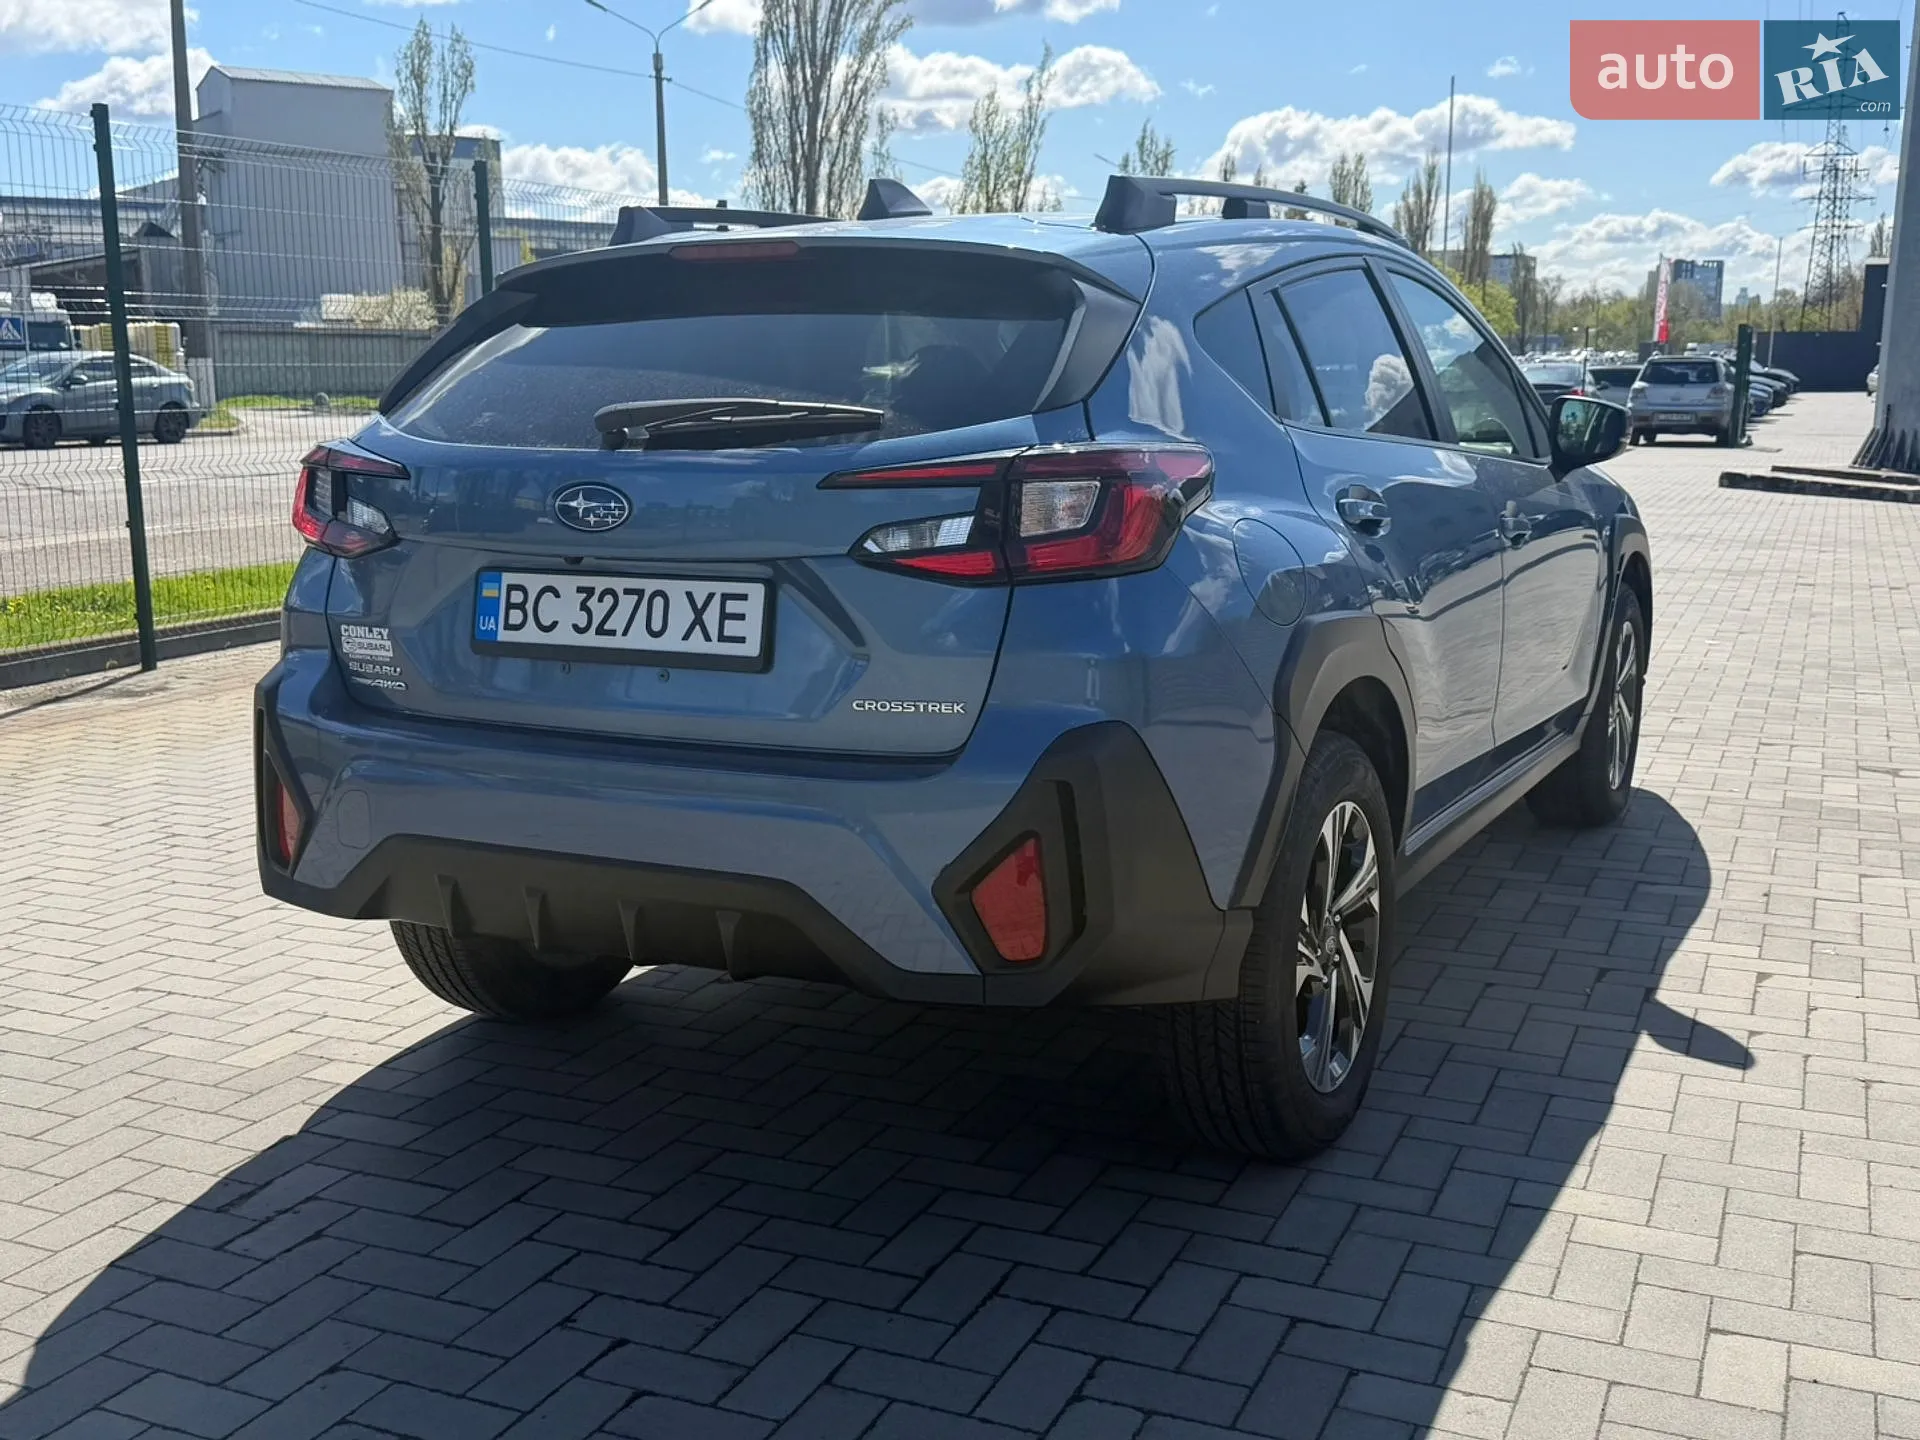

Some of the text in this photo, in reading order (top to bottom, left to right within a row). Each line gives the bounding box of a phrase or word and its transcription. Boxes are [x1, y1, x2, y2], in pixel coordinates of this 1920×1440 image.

[503, 583, 749, 644] BC 3270 XE
[479, 615, 497, 631] UA
[341, 624, 388, 640] CONLEY
[349, 661, 401, 676] SUBARU
[370, 679, 407, 691] AWD
[852, 699, 965, 714] CROSSTREK
